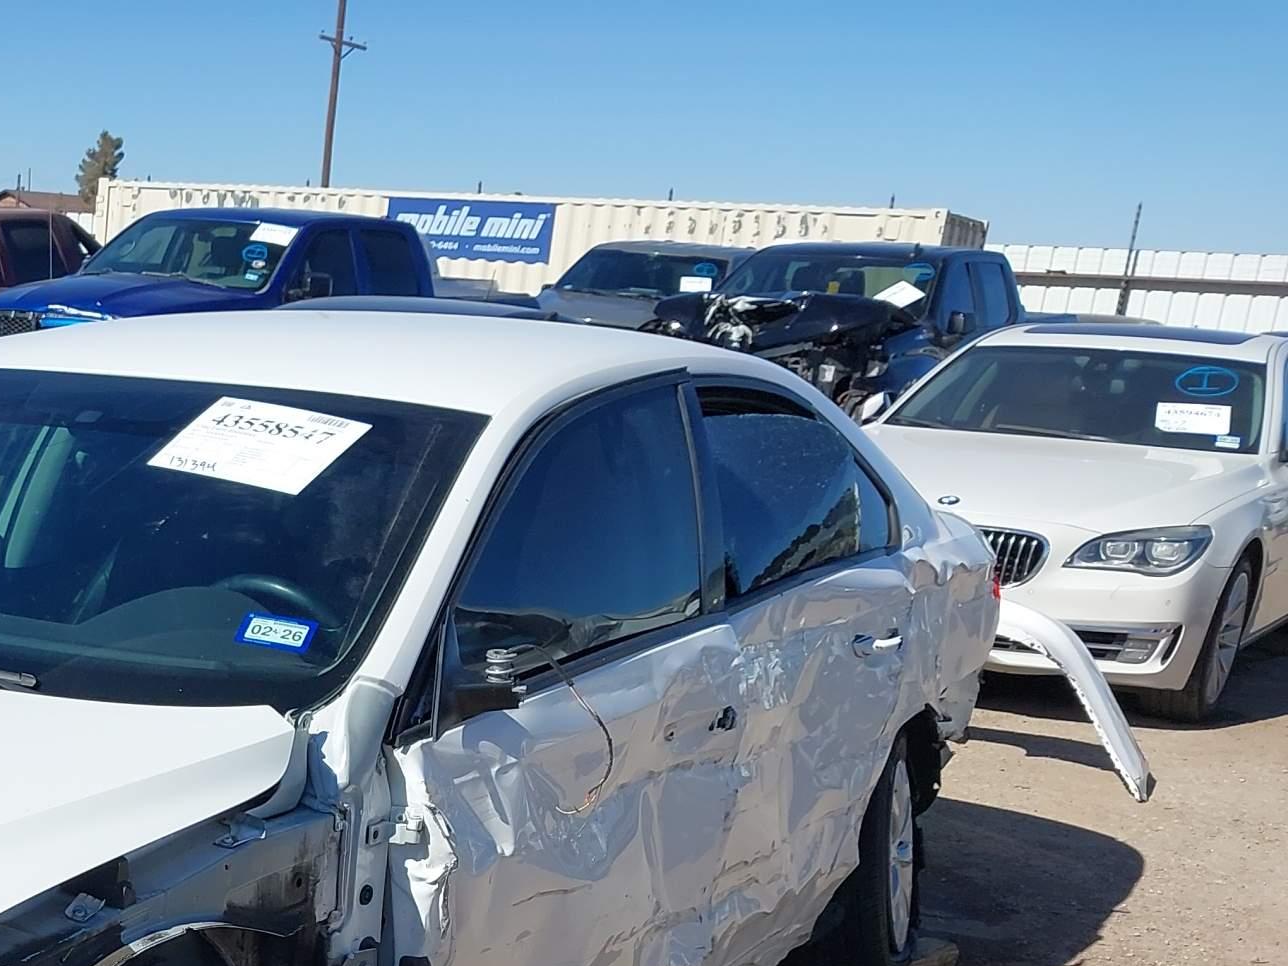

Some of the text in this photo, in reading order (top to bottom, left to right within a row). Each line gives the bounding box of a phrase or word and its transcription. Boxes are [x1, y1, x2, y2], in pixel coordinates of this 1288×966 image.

[396, 204, 547, 241] mobile mini
[473, 244, 540, 254] mobilemini.com
[211, 412, 337, 446] 43558547
